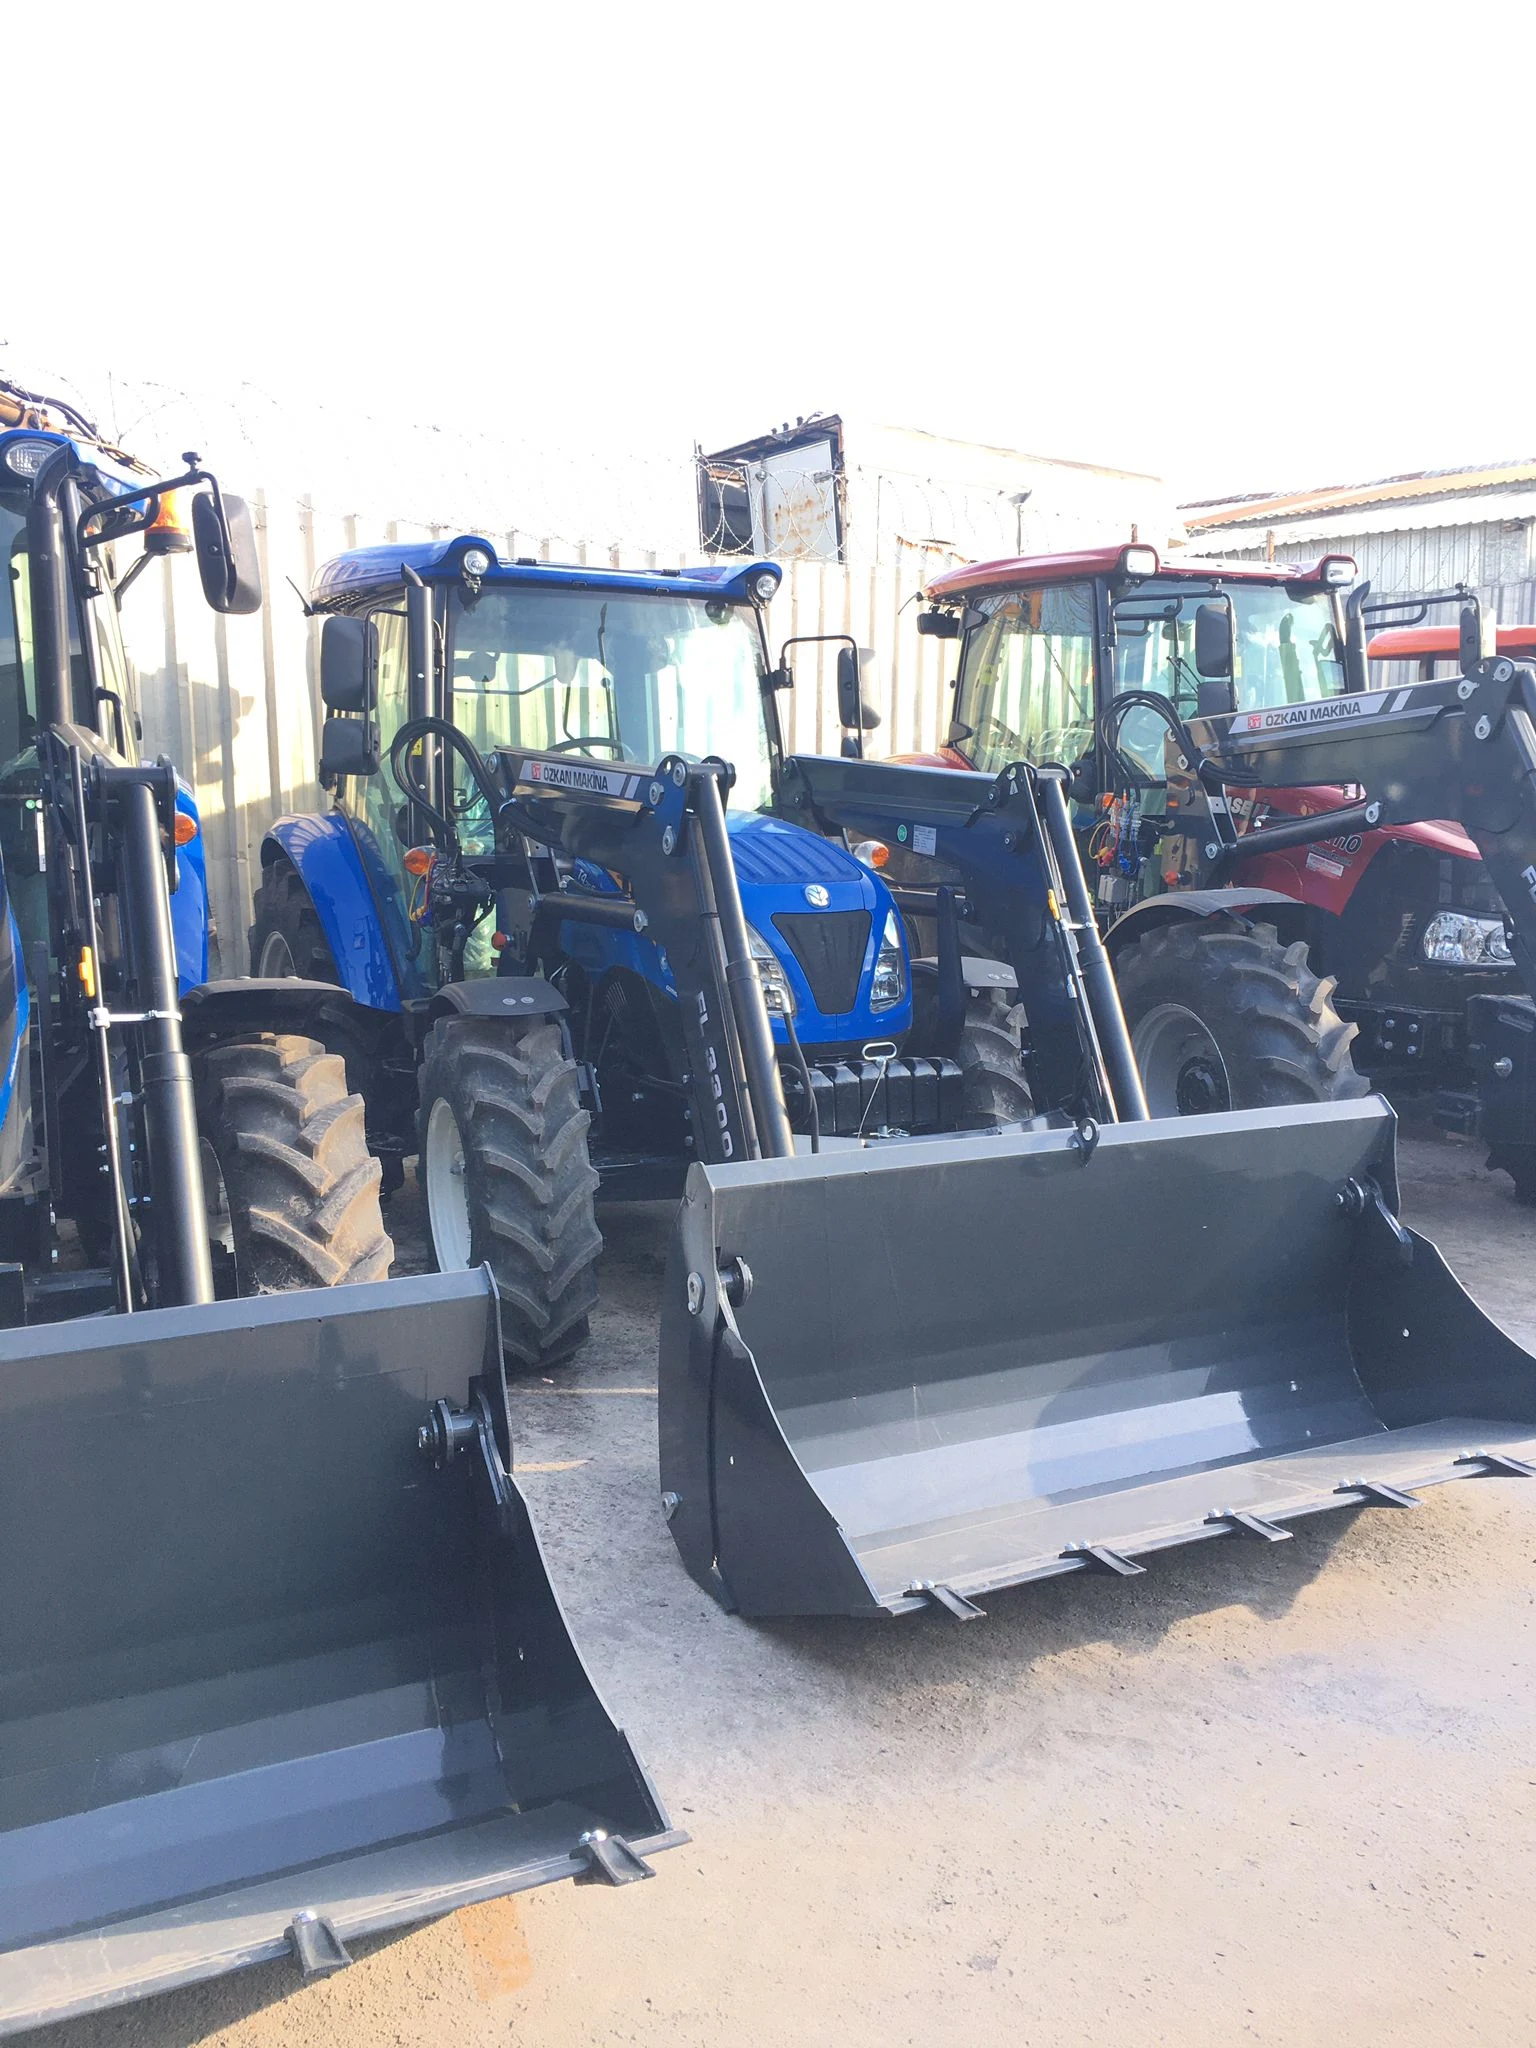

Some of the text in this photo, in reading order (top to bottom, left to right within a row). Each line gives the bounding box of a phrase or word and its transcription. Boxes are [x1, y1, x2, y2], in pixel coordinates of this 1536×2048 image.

[1265, 709, 1307, 727] ÖZKAN
[1310, 701, 1361, 721] MAKİNA
[543, 765, 572, 786] ÖZKAN
[573, 770, 609, 792] MAKİNA
[696, 990, 734, 1158] FL 3300
